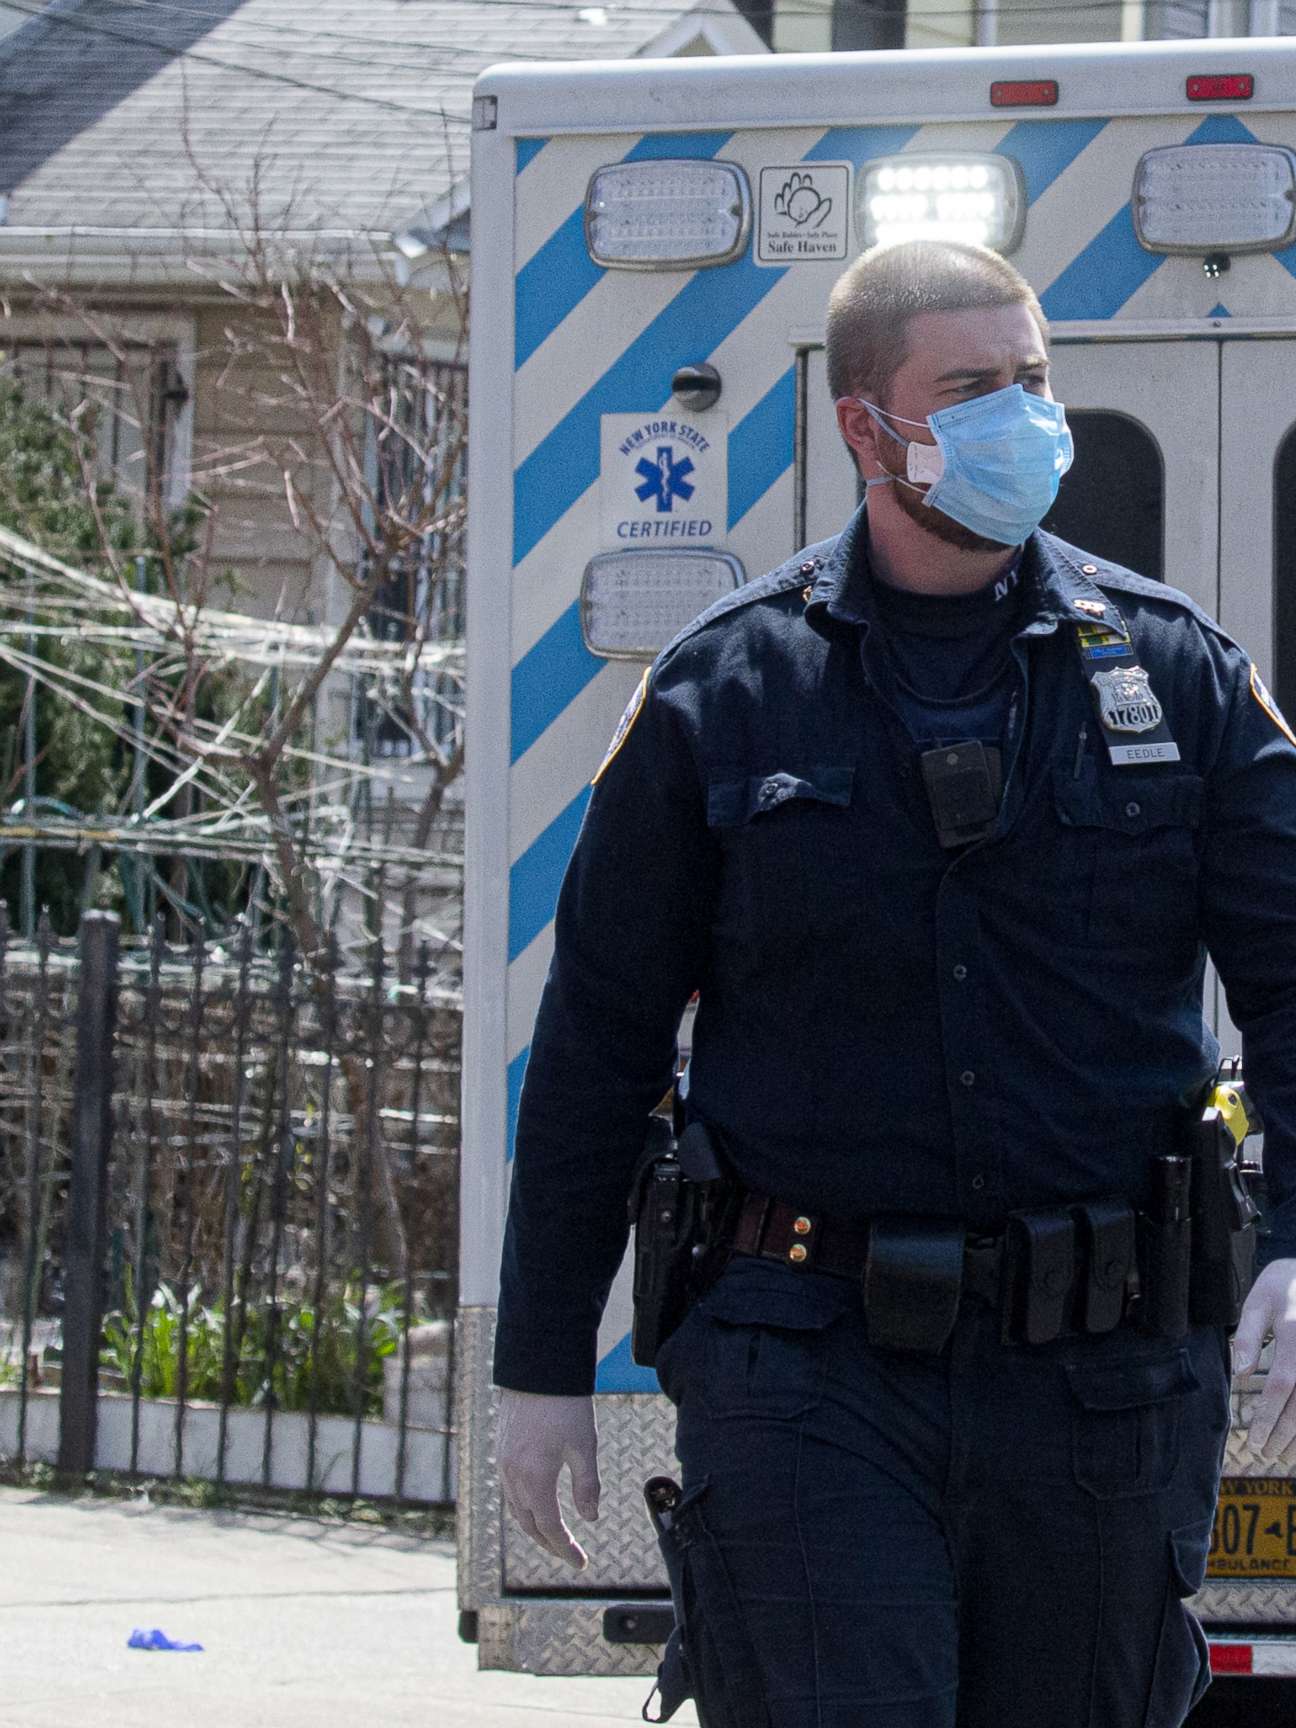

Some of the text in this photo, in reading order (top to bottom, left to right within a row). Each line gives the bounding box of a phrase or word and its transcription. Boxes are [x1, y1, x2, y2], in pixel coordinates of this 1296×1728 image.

[768, 241, 837, 253] Safe Haven
[619, 430, 645, 456] NEW
[644, 421, 678, 436] YORK
[679, 425, 711, 453] STATE
[617, 520, 712, 538] CERTIFIED
[1246, 1480, 1293, 1496] YORK
